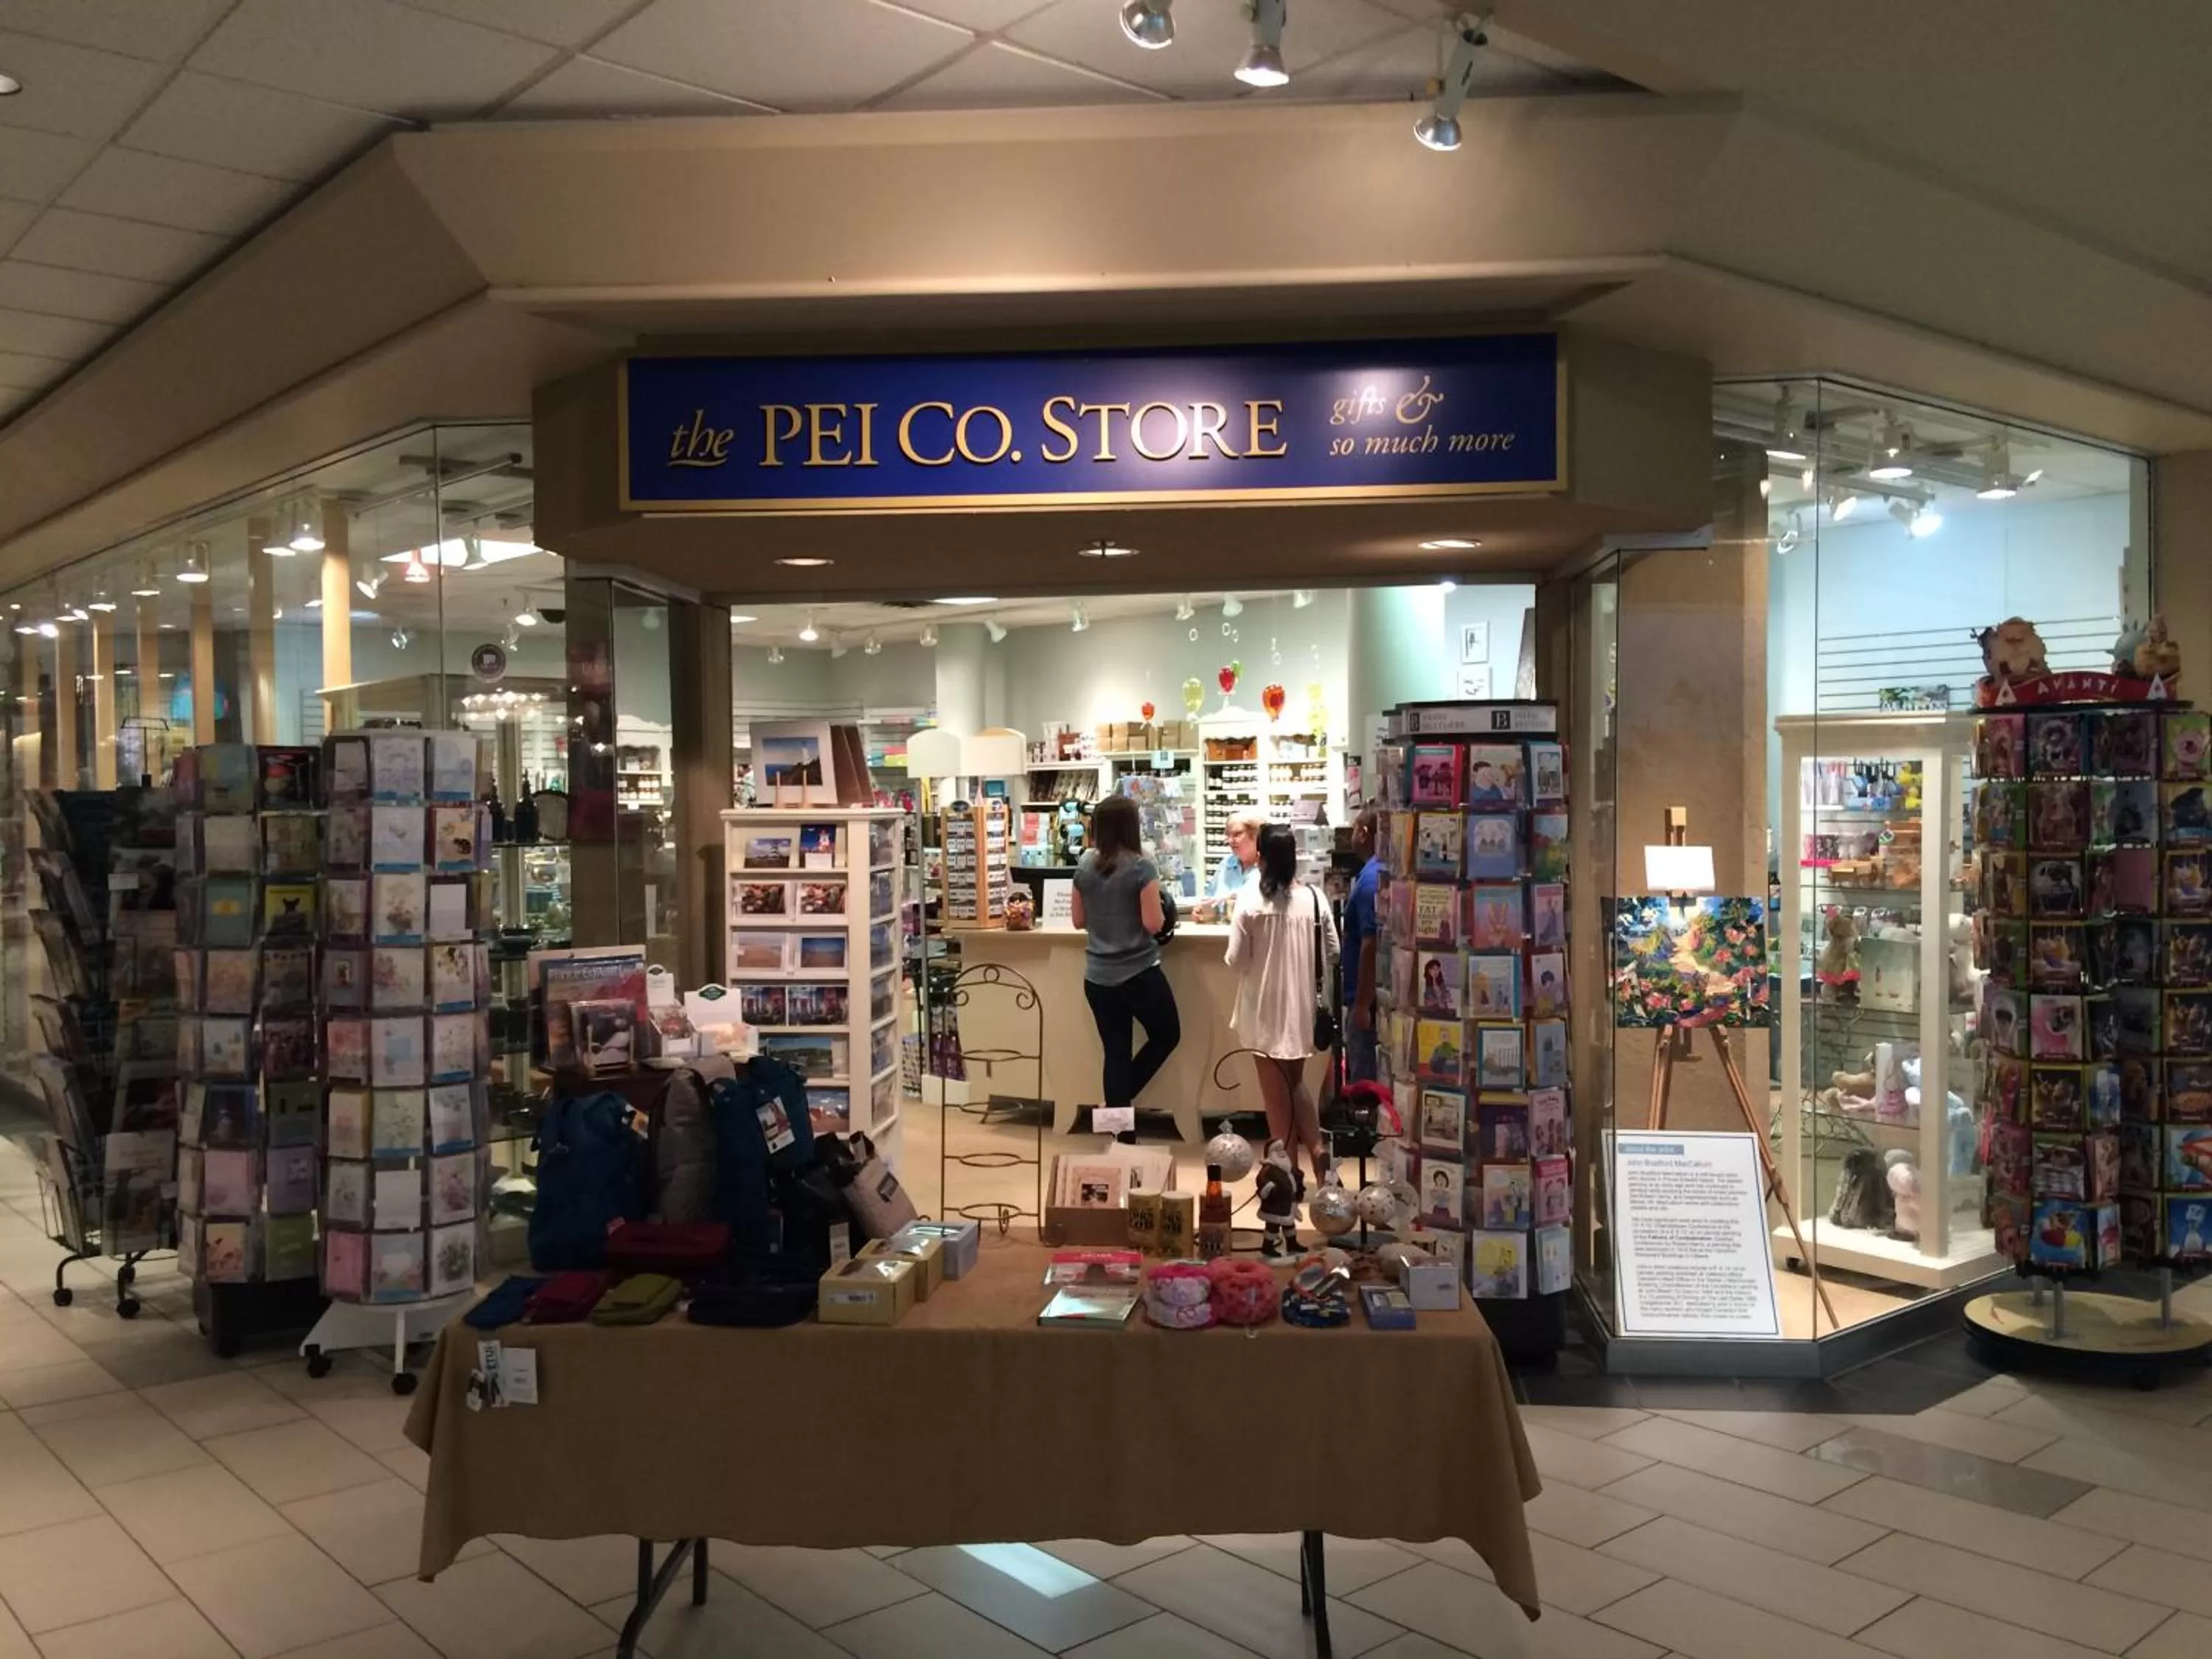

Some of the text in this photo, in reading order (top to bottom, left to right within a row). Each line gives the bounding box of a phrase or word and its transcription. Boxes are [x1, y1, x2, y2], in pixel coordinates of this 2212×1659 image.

[1329, 376, 1445, 425] gifts &
[667, 408, 734, 466] the
[758, 403, 879, 466] PEI
[1041, 396, 1288, 462] STORE
[1329, 425, 1516, 456] so much more
[2037, 678, 2119, 695] AVANTI
